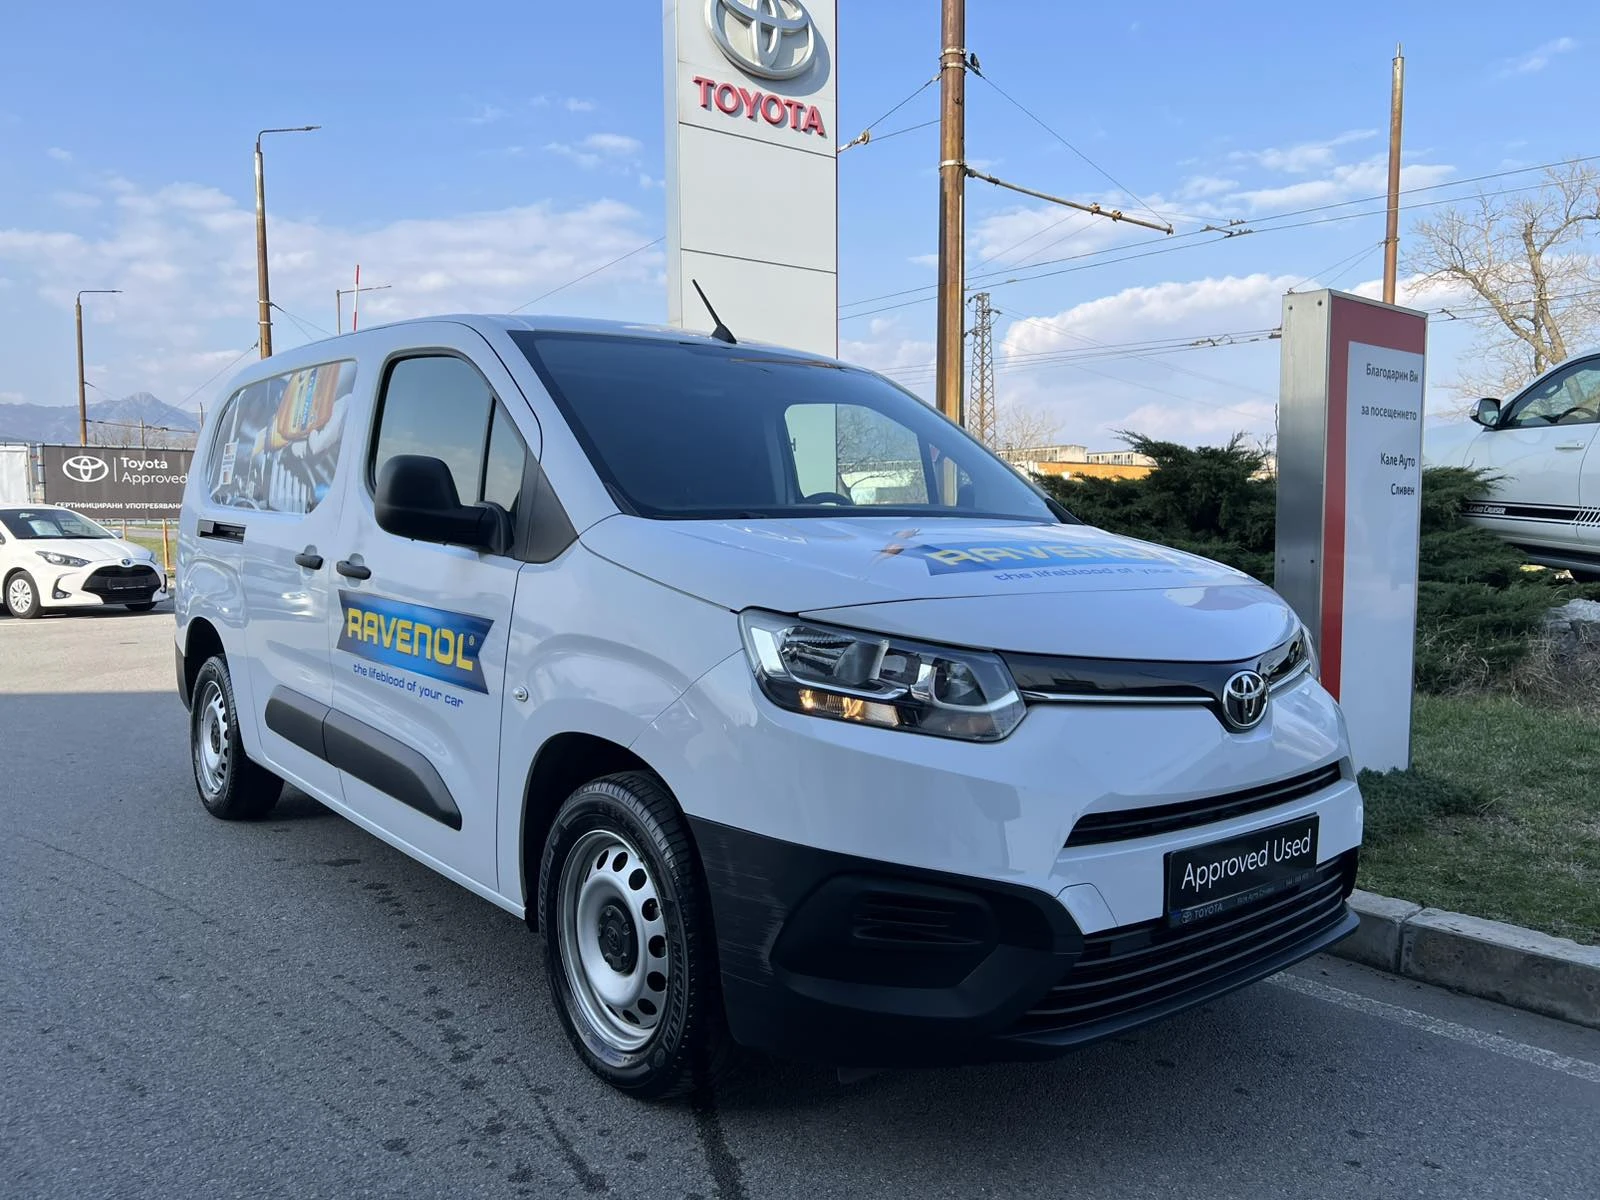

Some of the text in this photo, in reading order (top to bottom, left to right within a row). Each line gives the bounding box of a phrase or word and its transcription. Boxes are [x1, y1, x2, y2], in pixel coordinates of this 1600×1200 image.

[693, 76, 825, 136] TOYOTA
[1366, 363, 1419, 383] Благодарим Ви
[1361, 405, 1417, 421] за посещението
[120, 456, 168, 471] Toyota
[1380, 451, 1416, 470] Кале Ауто
[121, 471, 188, 486] Approved
[1390, 483, 1415, 496] Сливен
[994, 569, 1032, 581] the
[1033, 567, 1113, 578] lifeblood
[353, 663, 464, 708] the lifeblood of your car
[1181, 828, 1312, 893] Approved Used
[1193, 903, 1223, 919] TOYOTA
